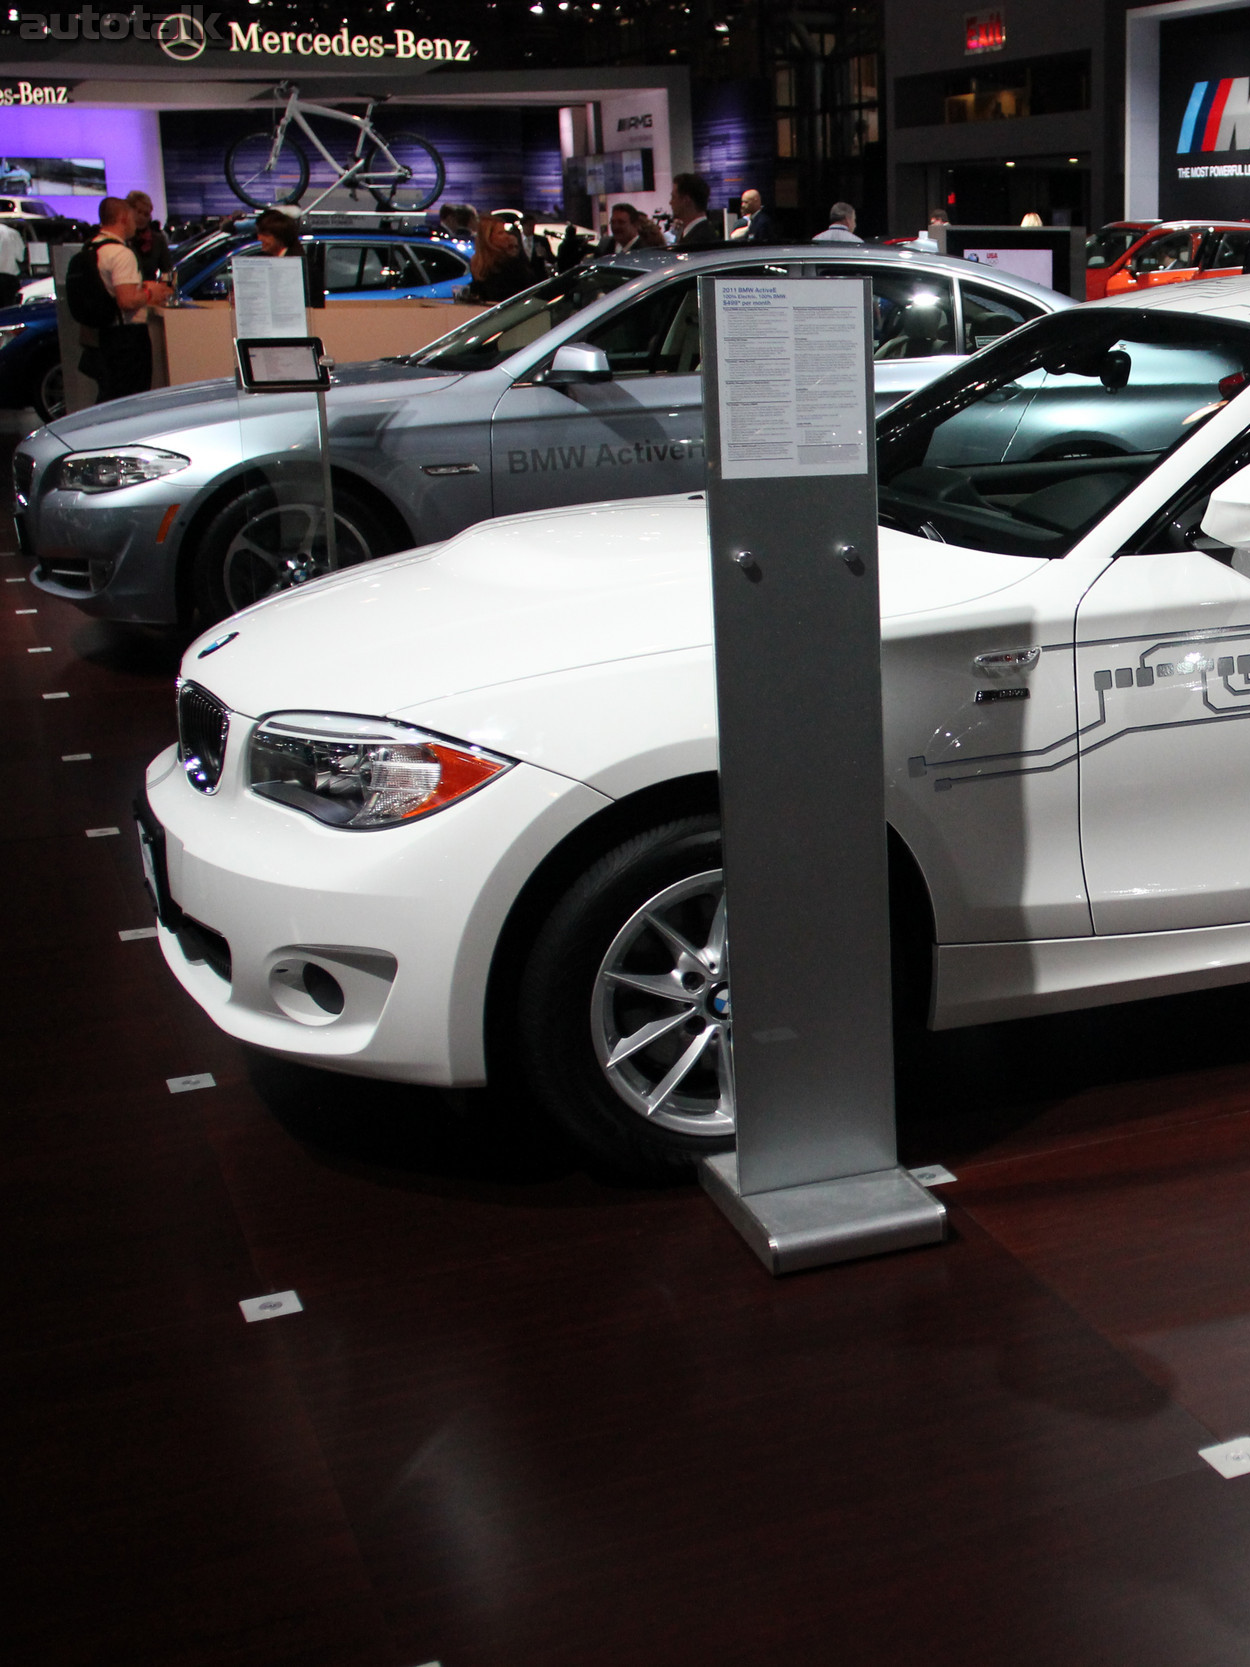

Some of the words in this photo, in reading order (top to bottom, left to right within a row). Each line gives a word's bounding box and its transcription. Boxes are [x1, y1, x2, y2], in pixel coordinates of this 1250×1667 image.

[228, 21, 471, 62] Mercedes-Benz
[1177, 167, 1191, 179] THE
[1191, 166, 1209, 178] MOST
[1209, 164, 1244, 177] POWERFUL
[508, 445, 586, 475] BMW
